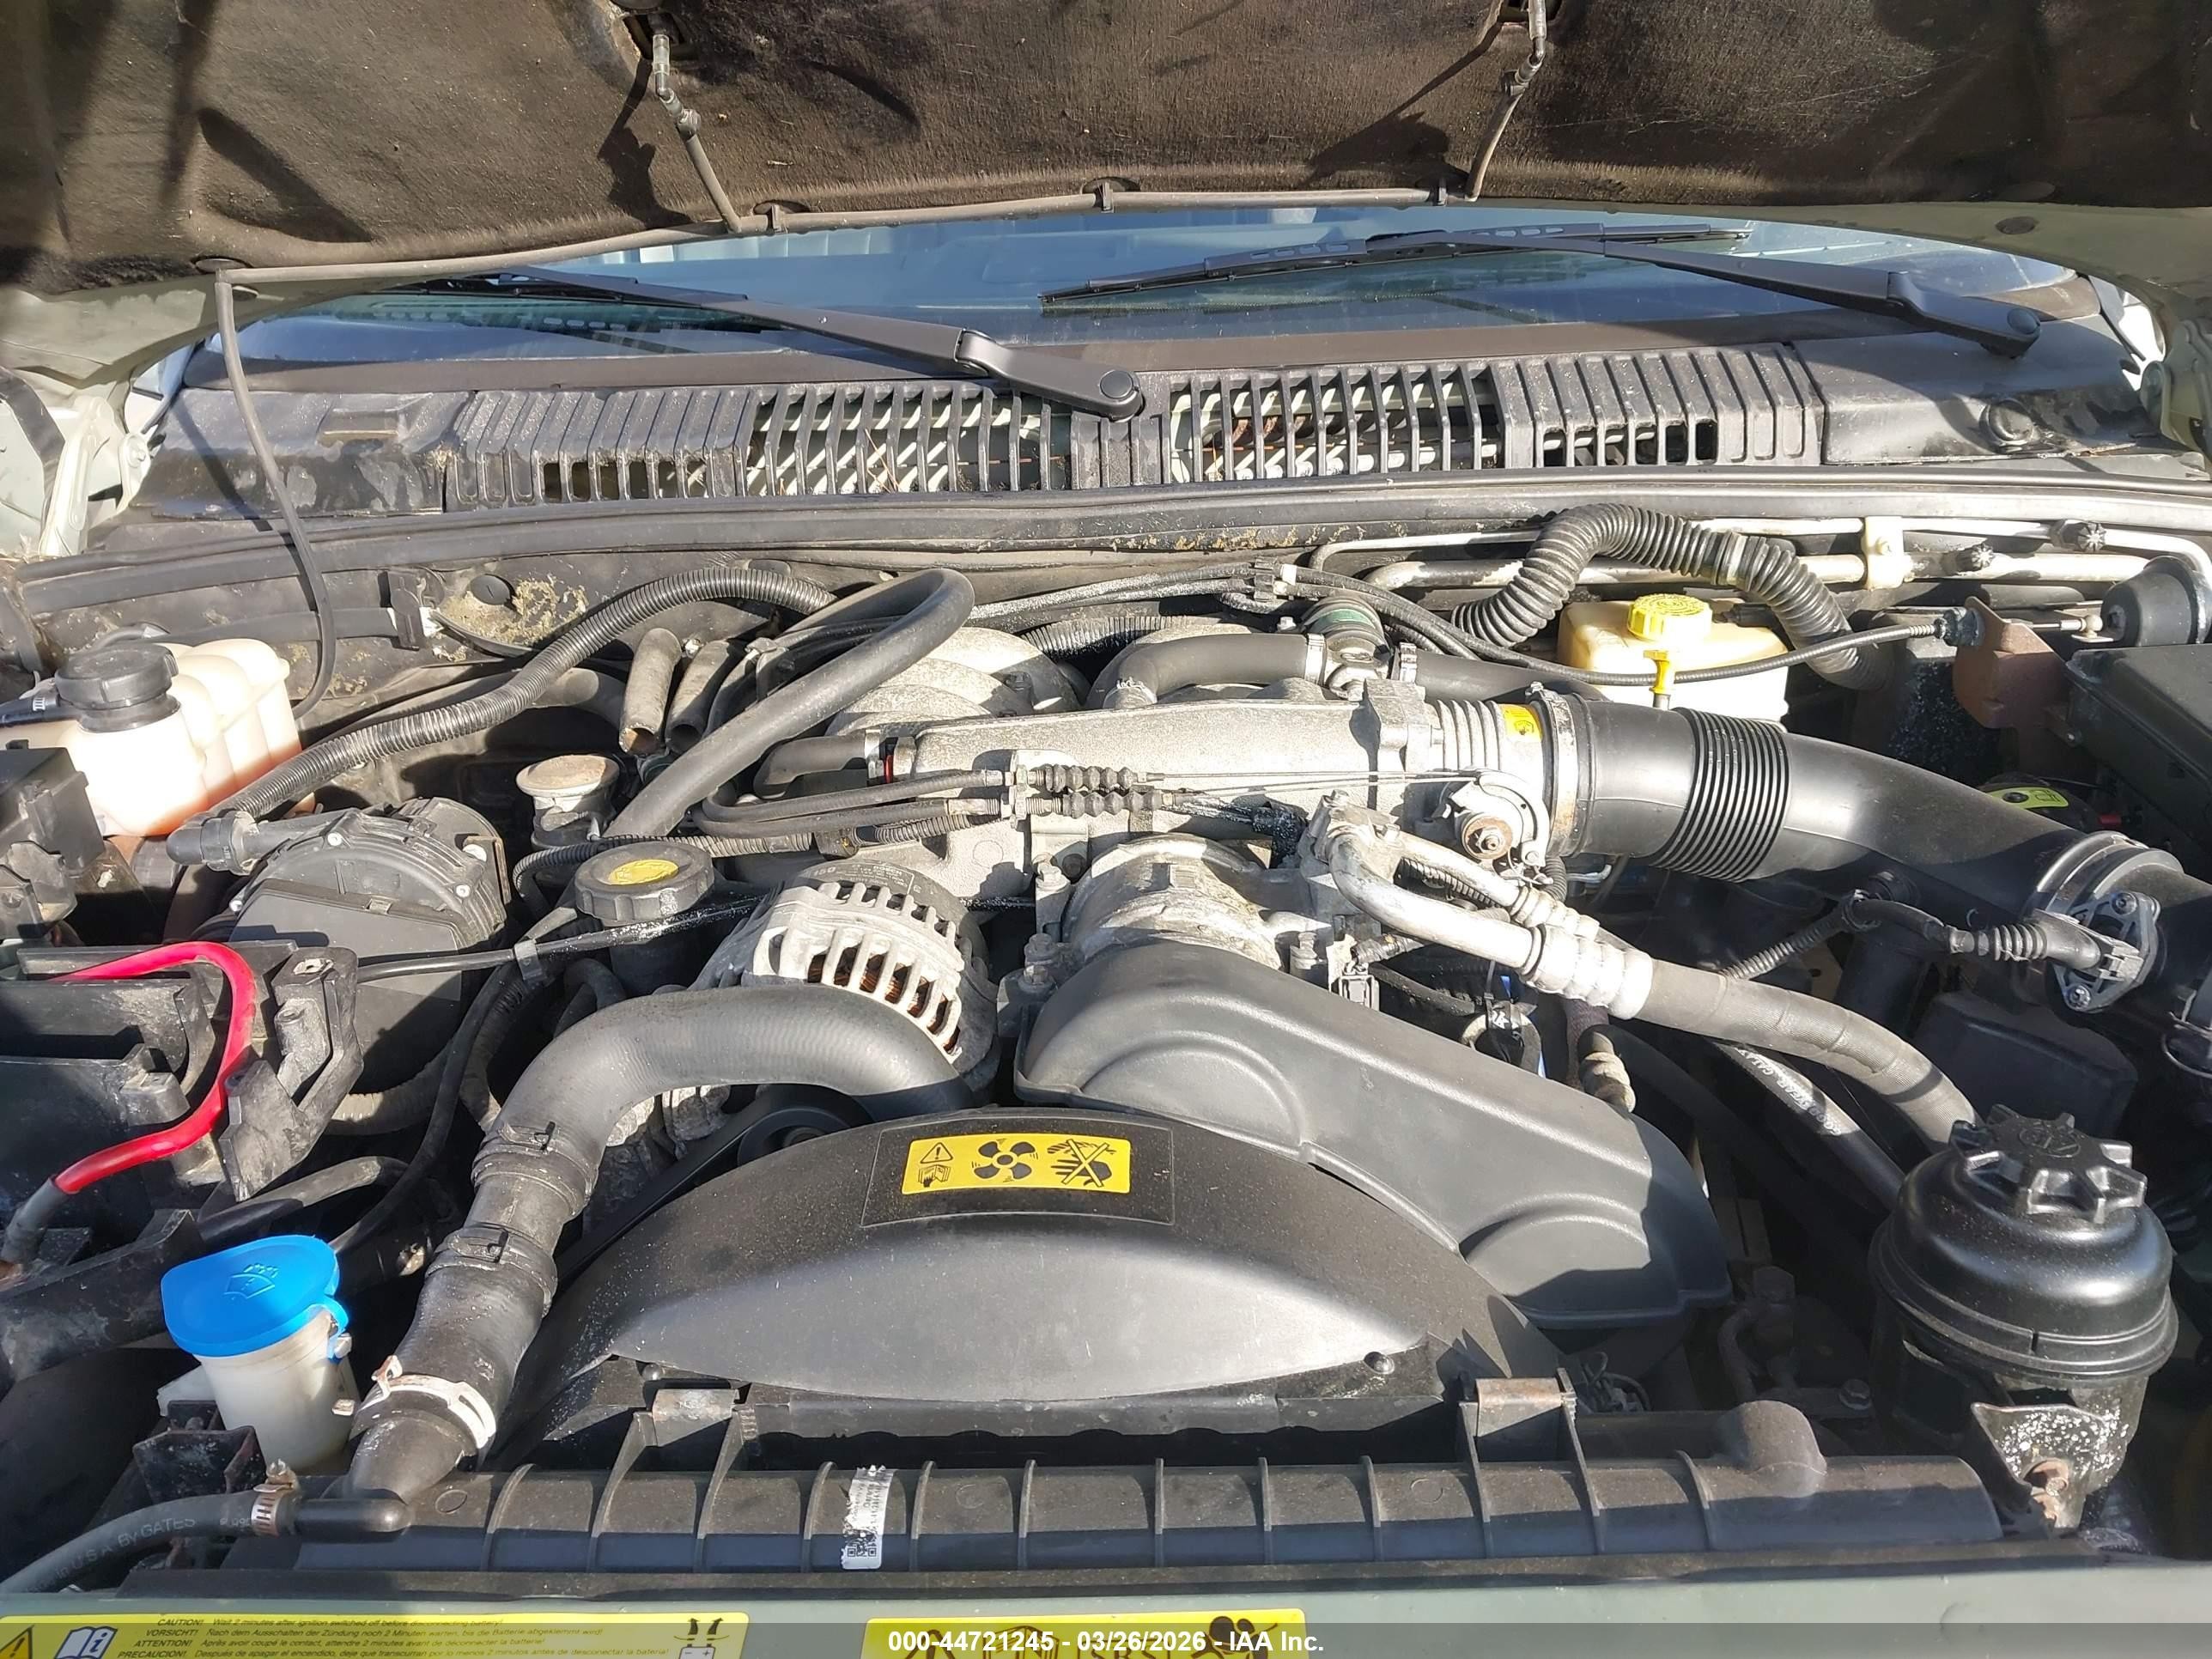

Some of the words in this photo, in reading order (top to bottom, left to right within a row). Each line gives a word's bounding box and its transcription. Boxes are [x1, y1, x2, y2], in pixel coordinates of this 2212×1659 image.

[140, 1517, 197, 1538] GATES
[296, 1620, 328, 1628] ignition
[133, 1639, 193, 1648] ATTENTION!
[200, 1639, 227, 1648] Après
[194, 1650, 234, 1659] Después
